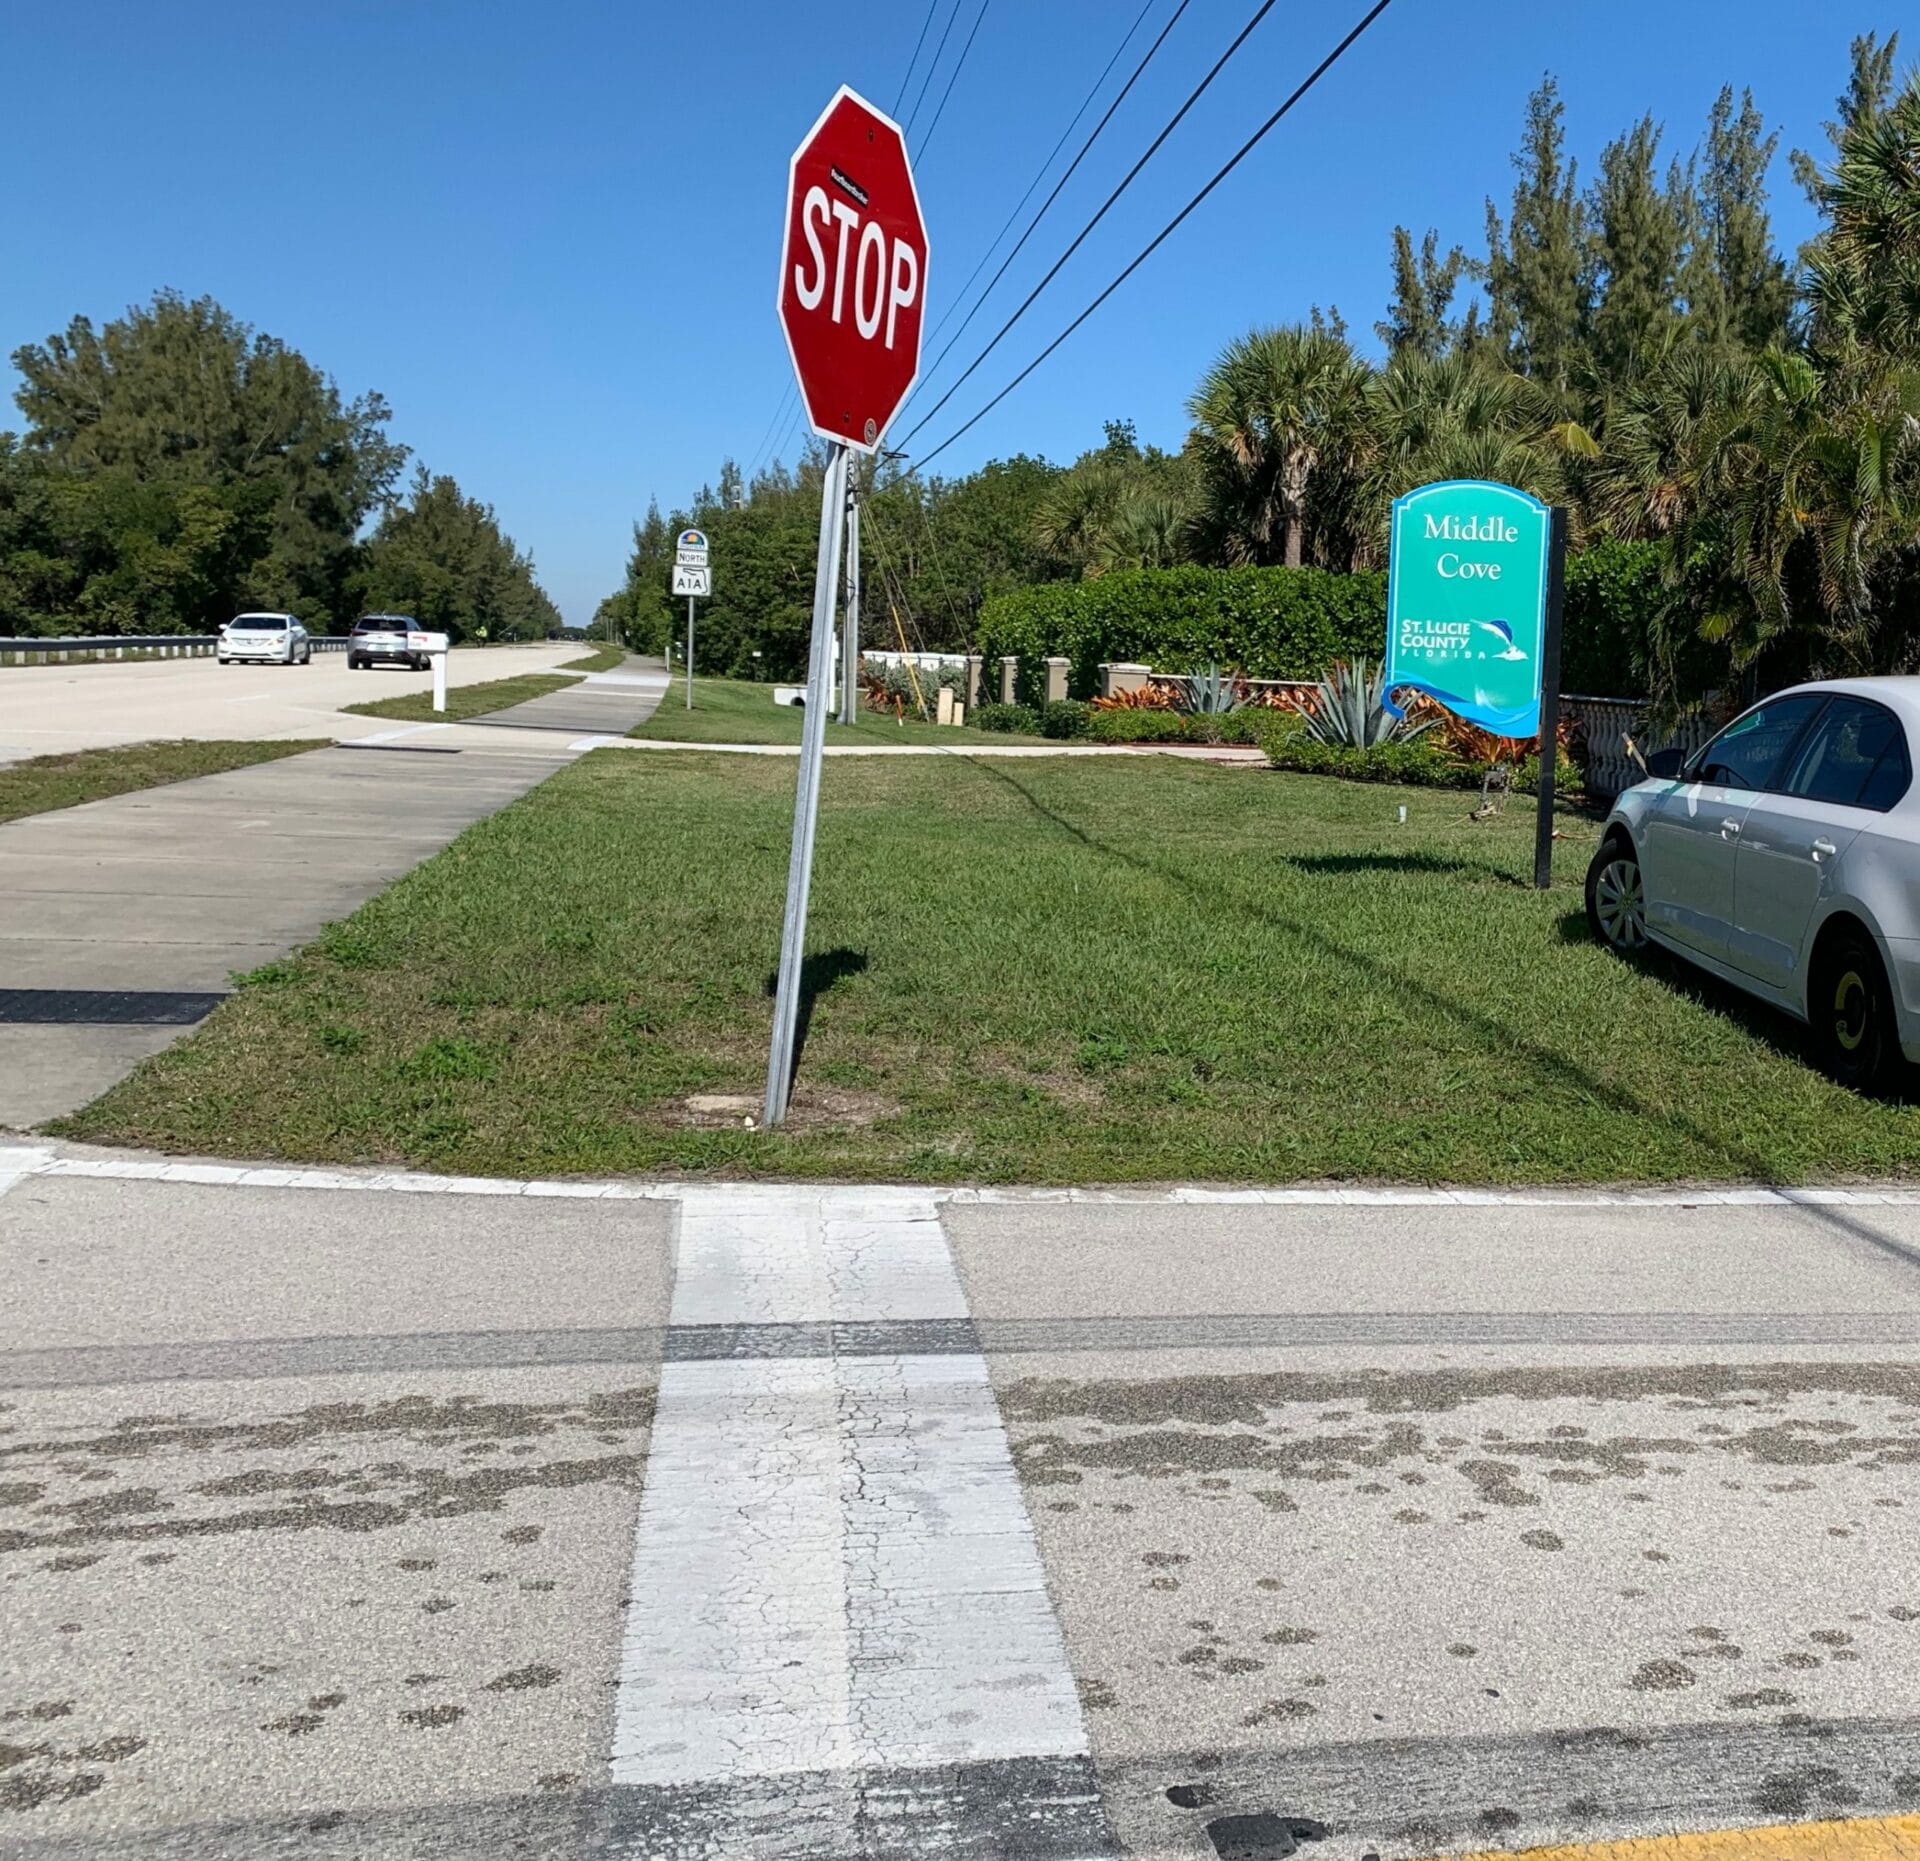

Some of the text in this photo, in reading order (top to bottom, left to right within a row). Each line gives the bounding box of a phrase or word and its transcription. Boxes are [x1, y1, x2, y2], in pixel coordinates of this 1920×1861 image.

[795, 186, 918, 350] STOP
[1423, 513, 1519, 543] Middle
[679, 553, 705, 563] NORTH
[1436, 552, 1502, 580] Cove
[676, 578, 702, 589] A1A
[1401, 619, 1471, 635] ST. LUCIE
[1401, 633, 1470, 649] COUNTY
[1401, 648, 1486, 660] FLORIDA
